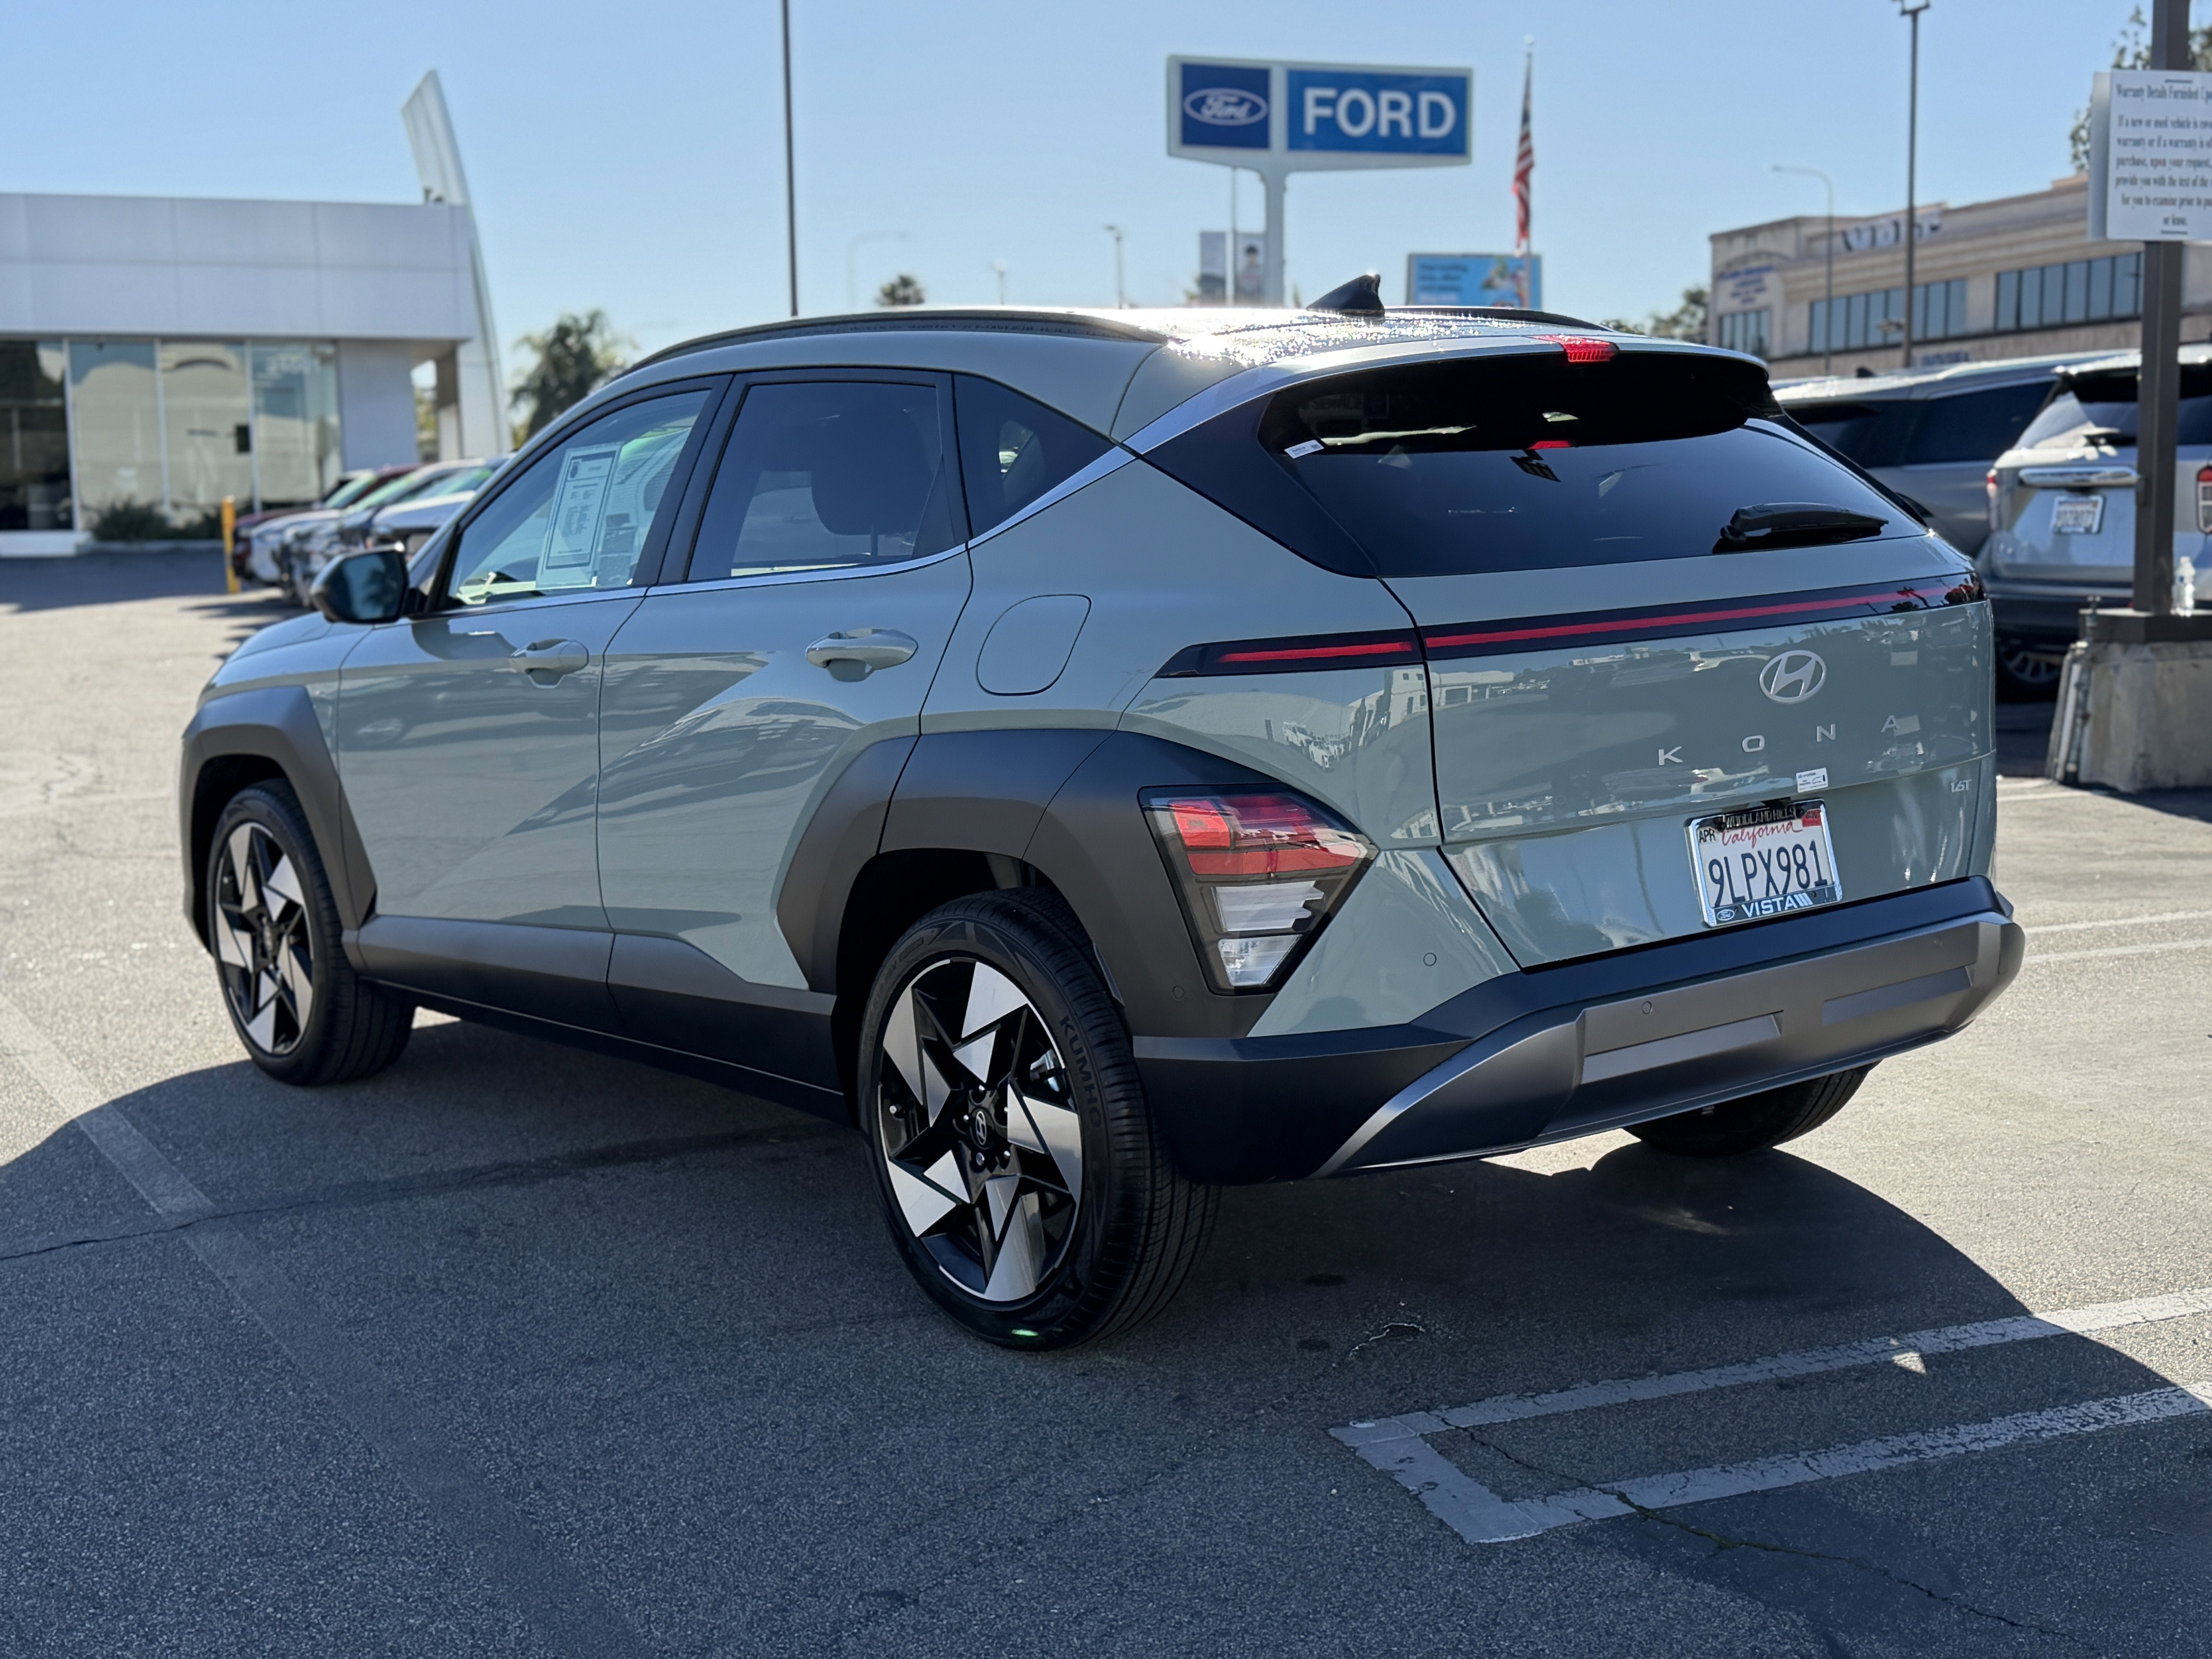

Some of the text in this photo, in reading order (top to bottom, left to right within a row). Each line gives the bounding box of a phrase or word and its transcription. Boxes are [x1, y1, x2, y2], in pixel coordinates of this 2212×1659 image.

[2116, 84, 2144, 102] Warranty
[1304, 87, 1456, 138] FORD
[2170, 116, 2191, 129] vehicle
[2117, 137, 2145, 150] warranty
[2169, 139, 2197, 151] warranty
[1658, 716, 1899, 766] KONA
[1699, 828, 1716, 843] APR
[1722, 821, 1803, 848] California
[1708, 840, 1827, 908] 9LPX981
[1741, 895, 1798, 917] VISTA
[1060, 1015, 1102, 1127] KUMHO
